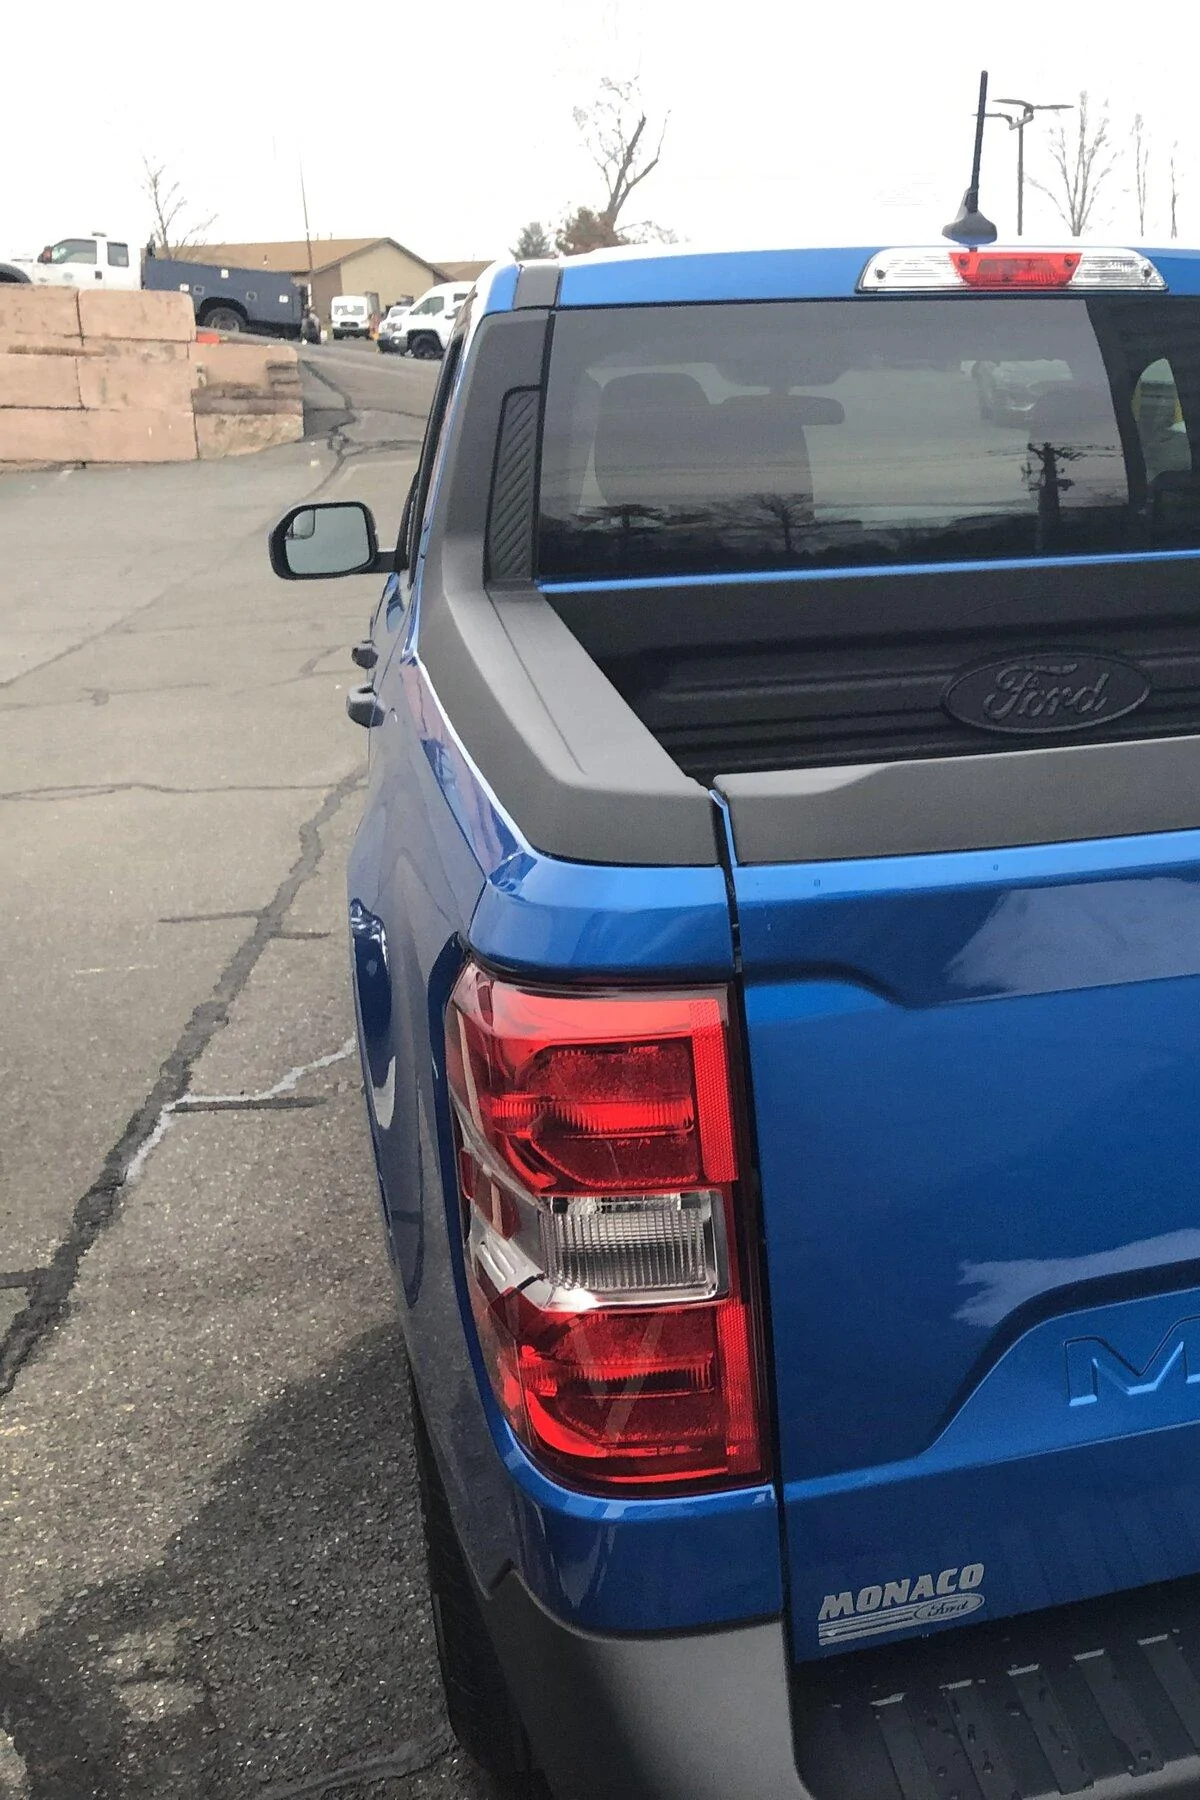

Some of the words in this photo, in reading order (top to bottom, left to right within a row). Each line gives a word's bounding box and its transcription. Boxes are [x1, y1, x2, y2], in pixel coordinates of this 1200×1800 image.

[983, 662, 1110, 720] Ford
[817, 1562, 985, 1621] MONACO
[926, 1599, 970, 1618] Ford
